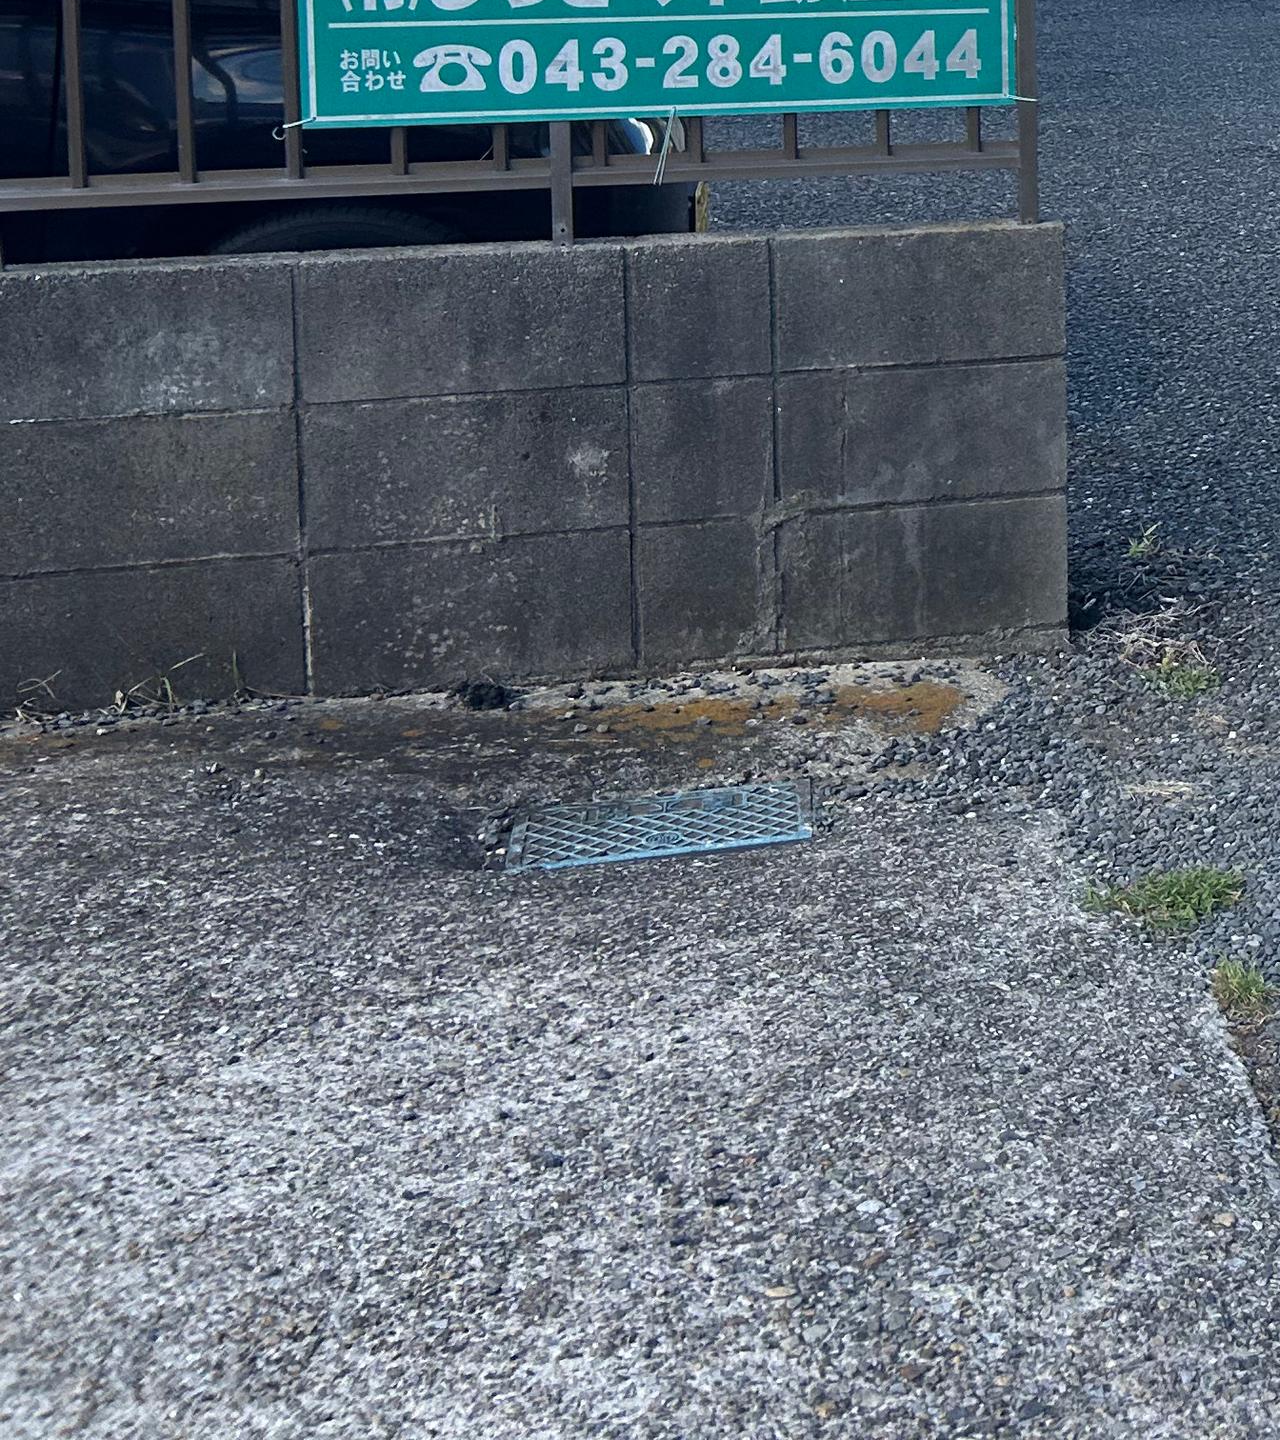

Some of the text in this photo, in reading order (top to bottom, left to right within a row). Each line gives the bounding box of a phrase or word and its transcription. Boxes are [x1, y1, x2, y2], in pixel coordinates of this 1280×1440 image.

[340, 49, 401, 70] お問い
[499, 29, 982, 94] 043-284-6044
[340, 71, 406, 93] 合わせ
